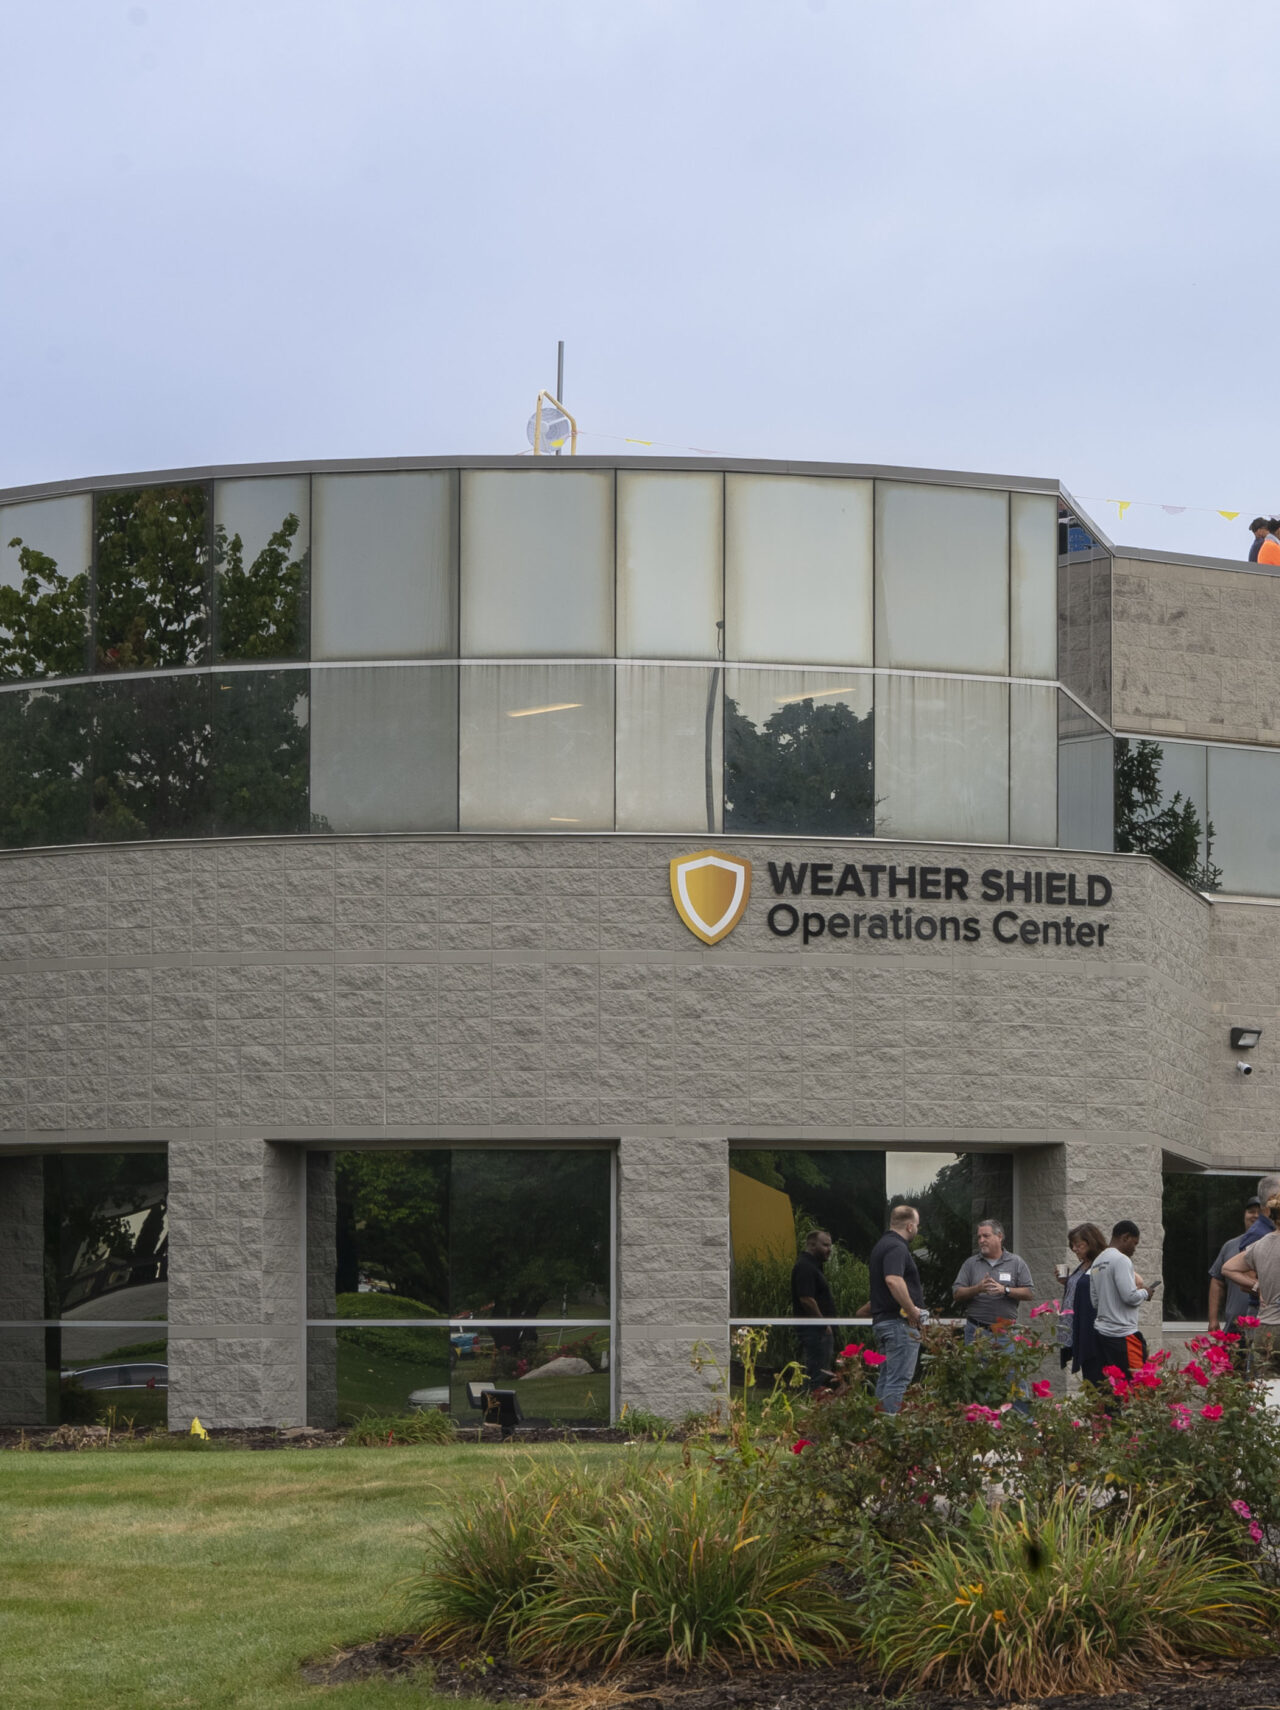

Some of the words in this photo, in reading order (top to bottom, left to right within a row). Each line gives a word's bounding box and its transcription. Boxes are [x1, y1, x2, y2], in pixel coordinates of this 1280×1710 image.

[767, 861, 969, 901] WEATHER
[981, 869, 1113, 907] SHIELD
[766, 903, 981, 945] Operations
[992, 910, 1110, 947] Center
